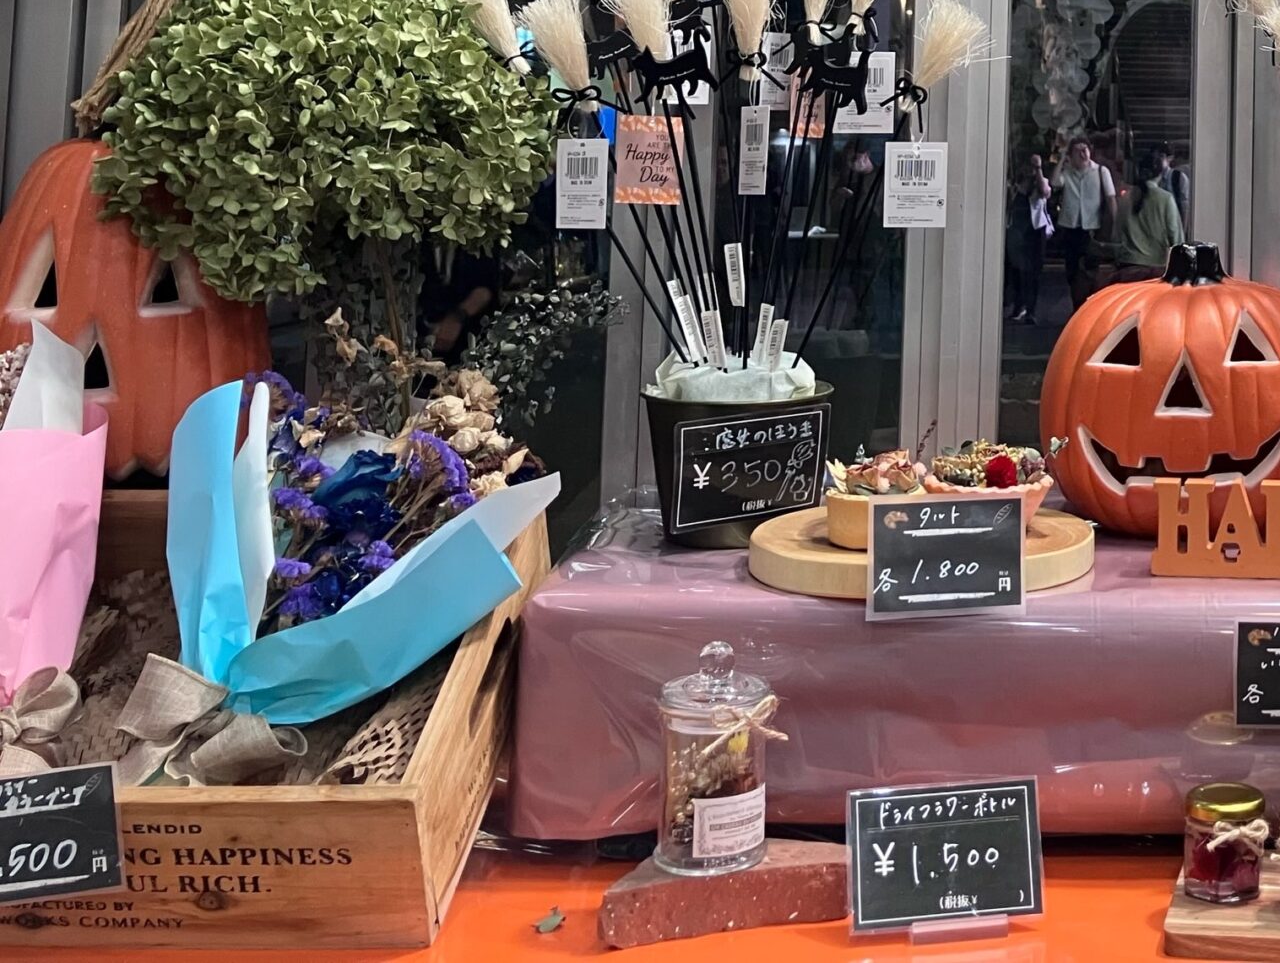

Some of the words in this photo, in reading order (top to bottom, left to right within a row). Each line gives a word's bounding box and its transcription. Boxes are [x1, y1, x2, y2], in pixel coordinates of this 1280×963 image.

[625, 143, 670, 165] Happy
[640, 165, 669, 187] Day
[172, 847, 353, 866] HAPPINESS
[178, 875, 272, 893] RICH.
[113, 901, 134, 911] BY
[79, 916, 185, 929] COMPANY
